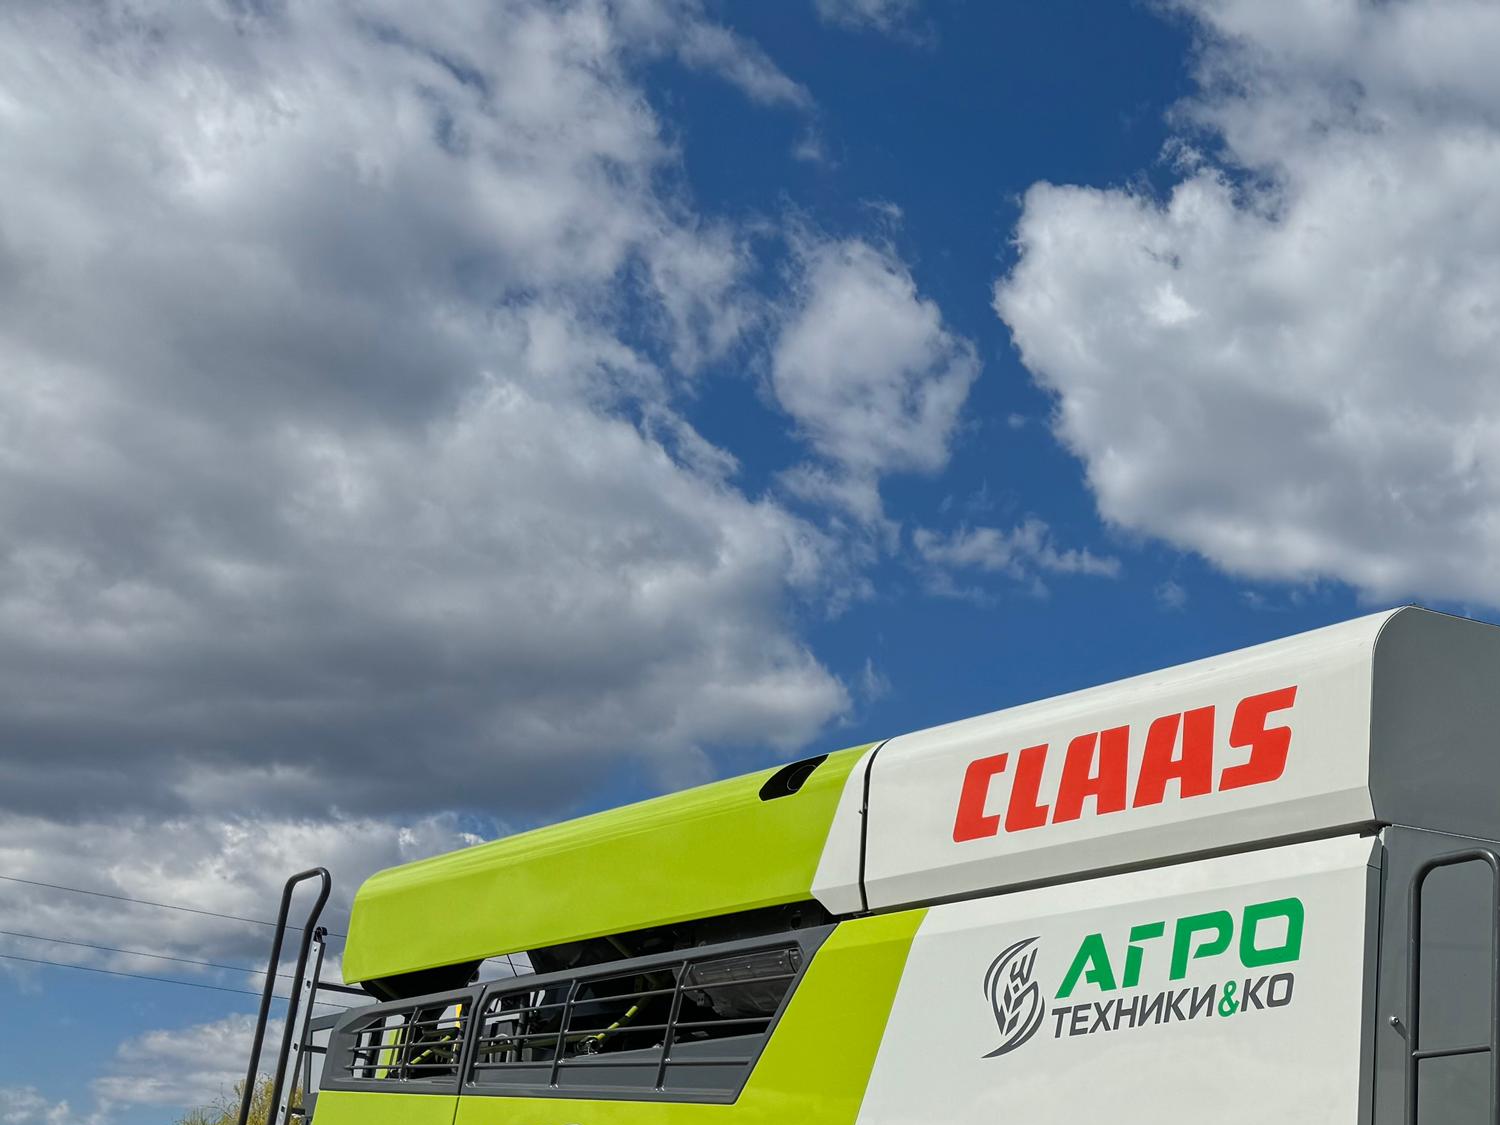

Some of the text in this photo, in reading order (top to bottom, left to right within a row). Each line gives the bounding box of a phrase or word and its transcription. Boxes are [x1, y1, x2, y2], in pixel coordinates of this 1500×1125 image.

[953, 685, 1298, 842] CLAAS
[1054, 897, 1304, 999] АГРО
[1051, 972, 1295, 1038] ТЕХНИКИ&КО
